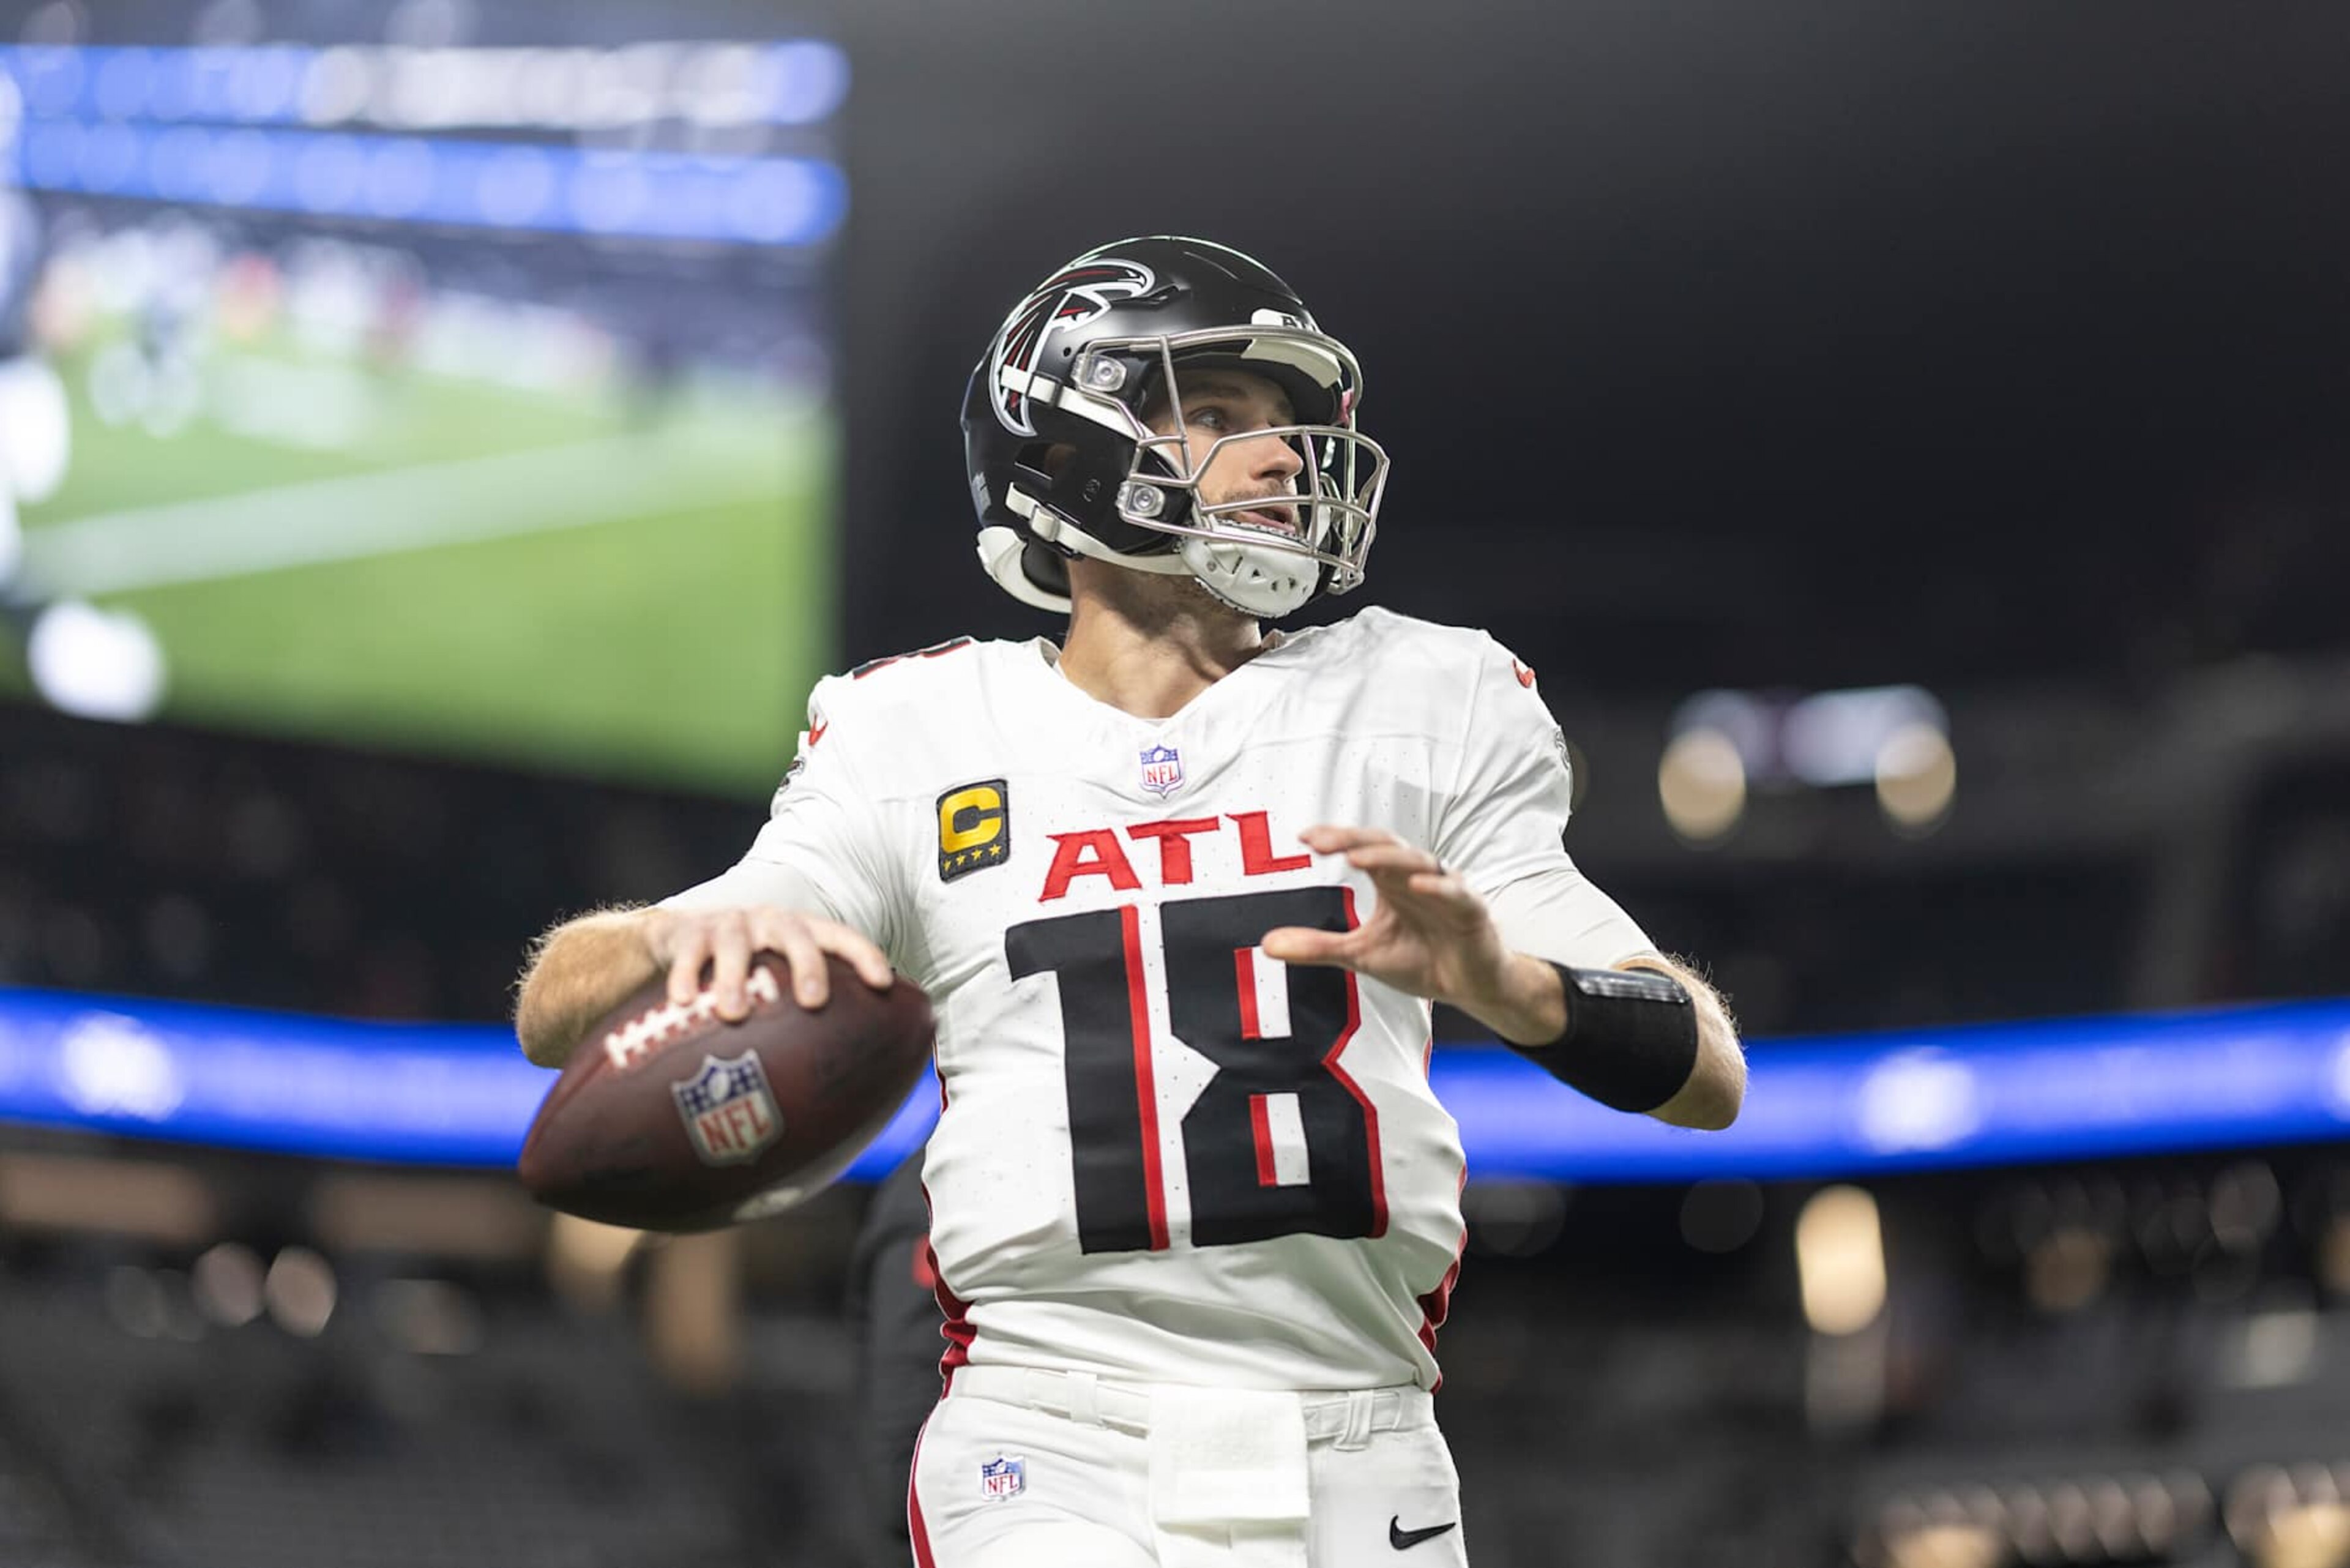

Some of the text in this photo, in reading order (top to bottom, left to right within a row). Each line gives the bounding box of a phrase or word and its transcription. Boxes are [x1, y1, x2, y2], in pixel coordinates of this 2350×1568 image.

[1147, 764, 1177, 784] NFL
[940, 786, 1002, 853] C
[1039, 810, 1311, 902] ATL
[1005, 886, 1389, 1255] 18
[698, 1099, 772, 1153] NFL
[988, 1474, 1018, 1493] NFL
